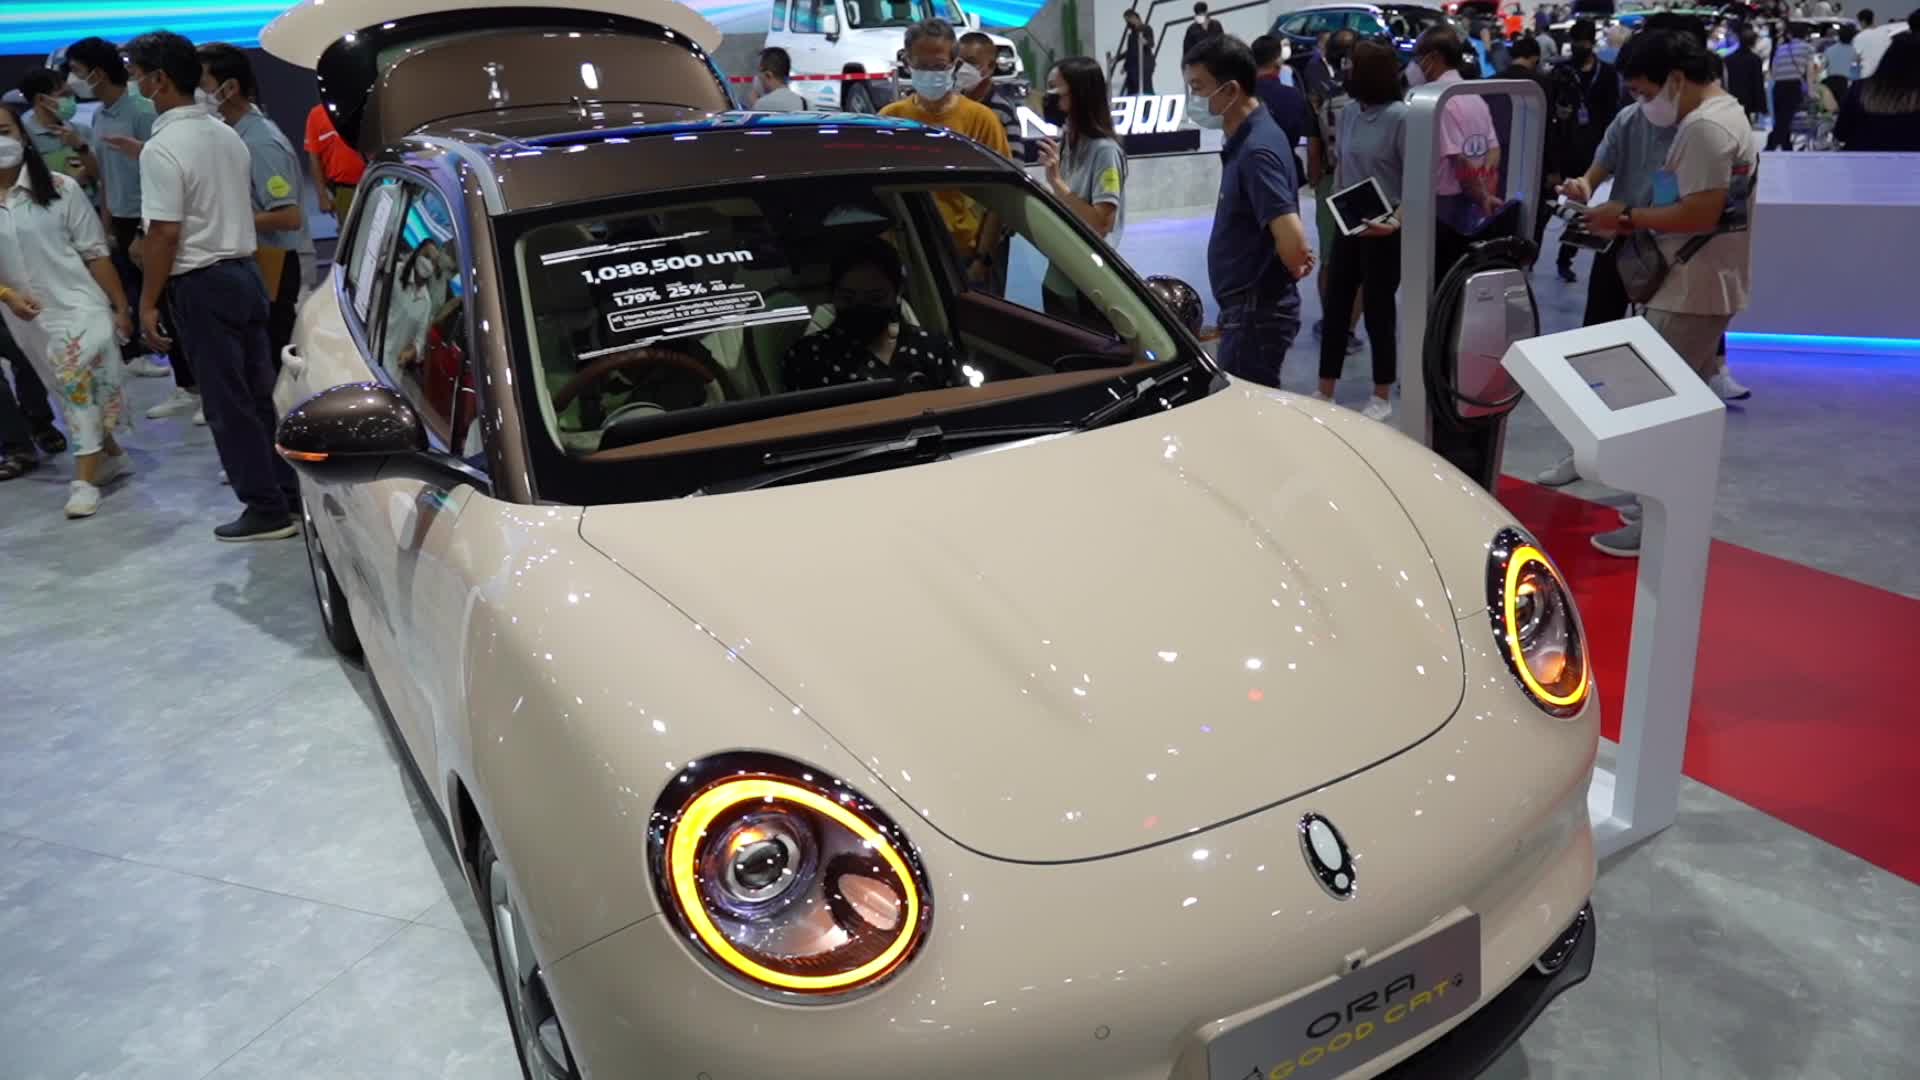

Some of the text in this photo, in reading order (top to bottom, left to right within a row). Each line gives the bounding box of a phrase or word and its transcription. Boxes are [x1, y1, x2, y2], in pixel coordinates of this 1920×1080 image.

[1111, 94, 1186, 135] 300
[581, 250, 753, 284] 1,038,500 บาท
[613, 289, 661, 307] 1.79%
[667, 283, 707, 299] 25%
[1306, 974, 1415, 1039] ORA
[1270, 979, 1450, 1080] GOOD CAT
